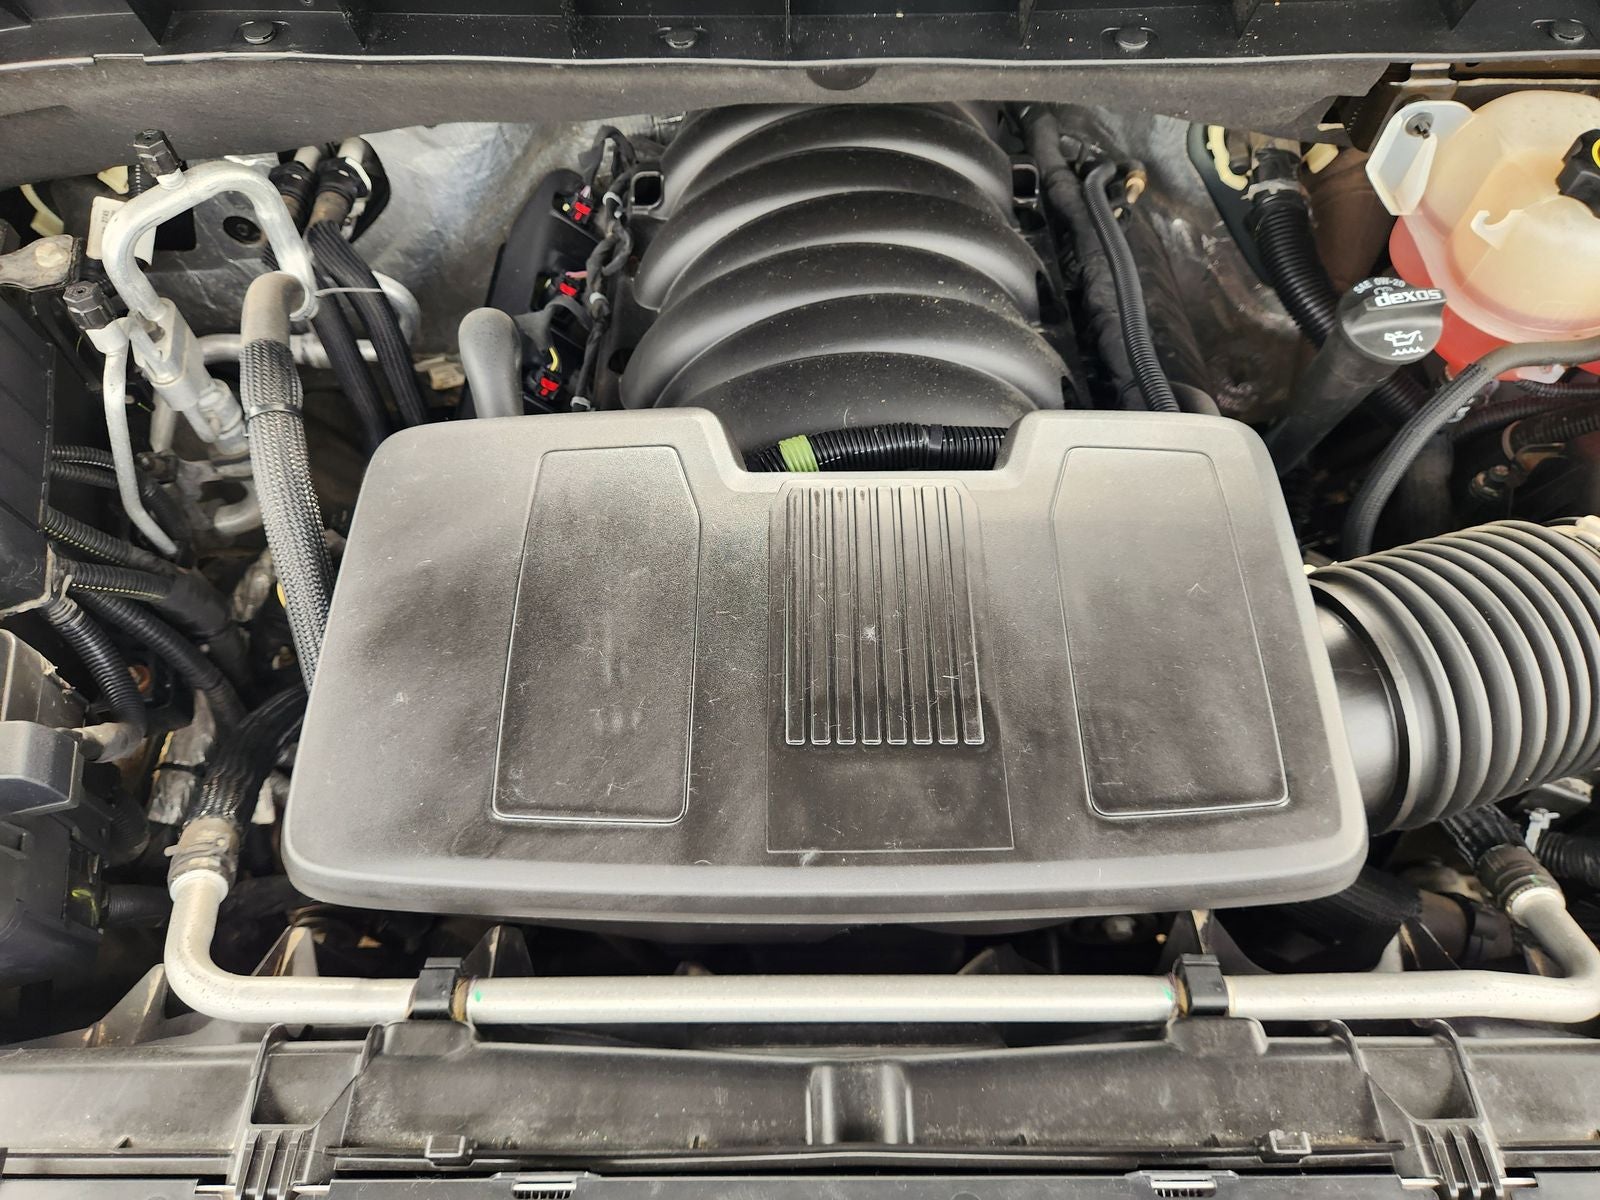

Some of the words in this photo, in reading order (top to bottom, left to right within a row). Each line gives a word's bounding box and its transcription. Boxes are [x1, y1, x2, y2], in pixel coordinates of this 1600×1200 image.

[1353, 280, 1373, 294] SAE
[1373, 277, 1406, 288] 0W-20
[1374, 289, 1442, 307] dexos
